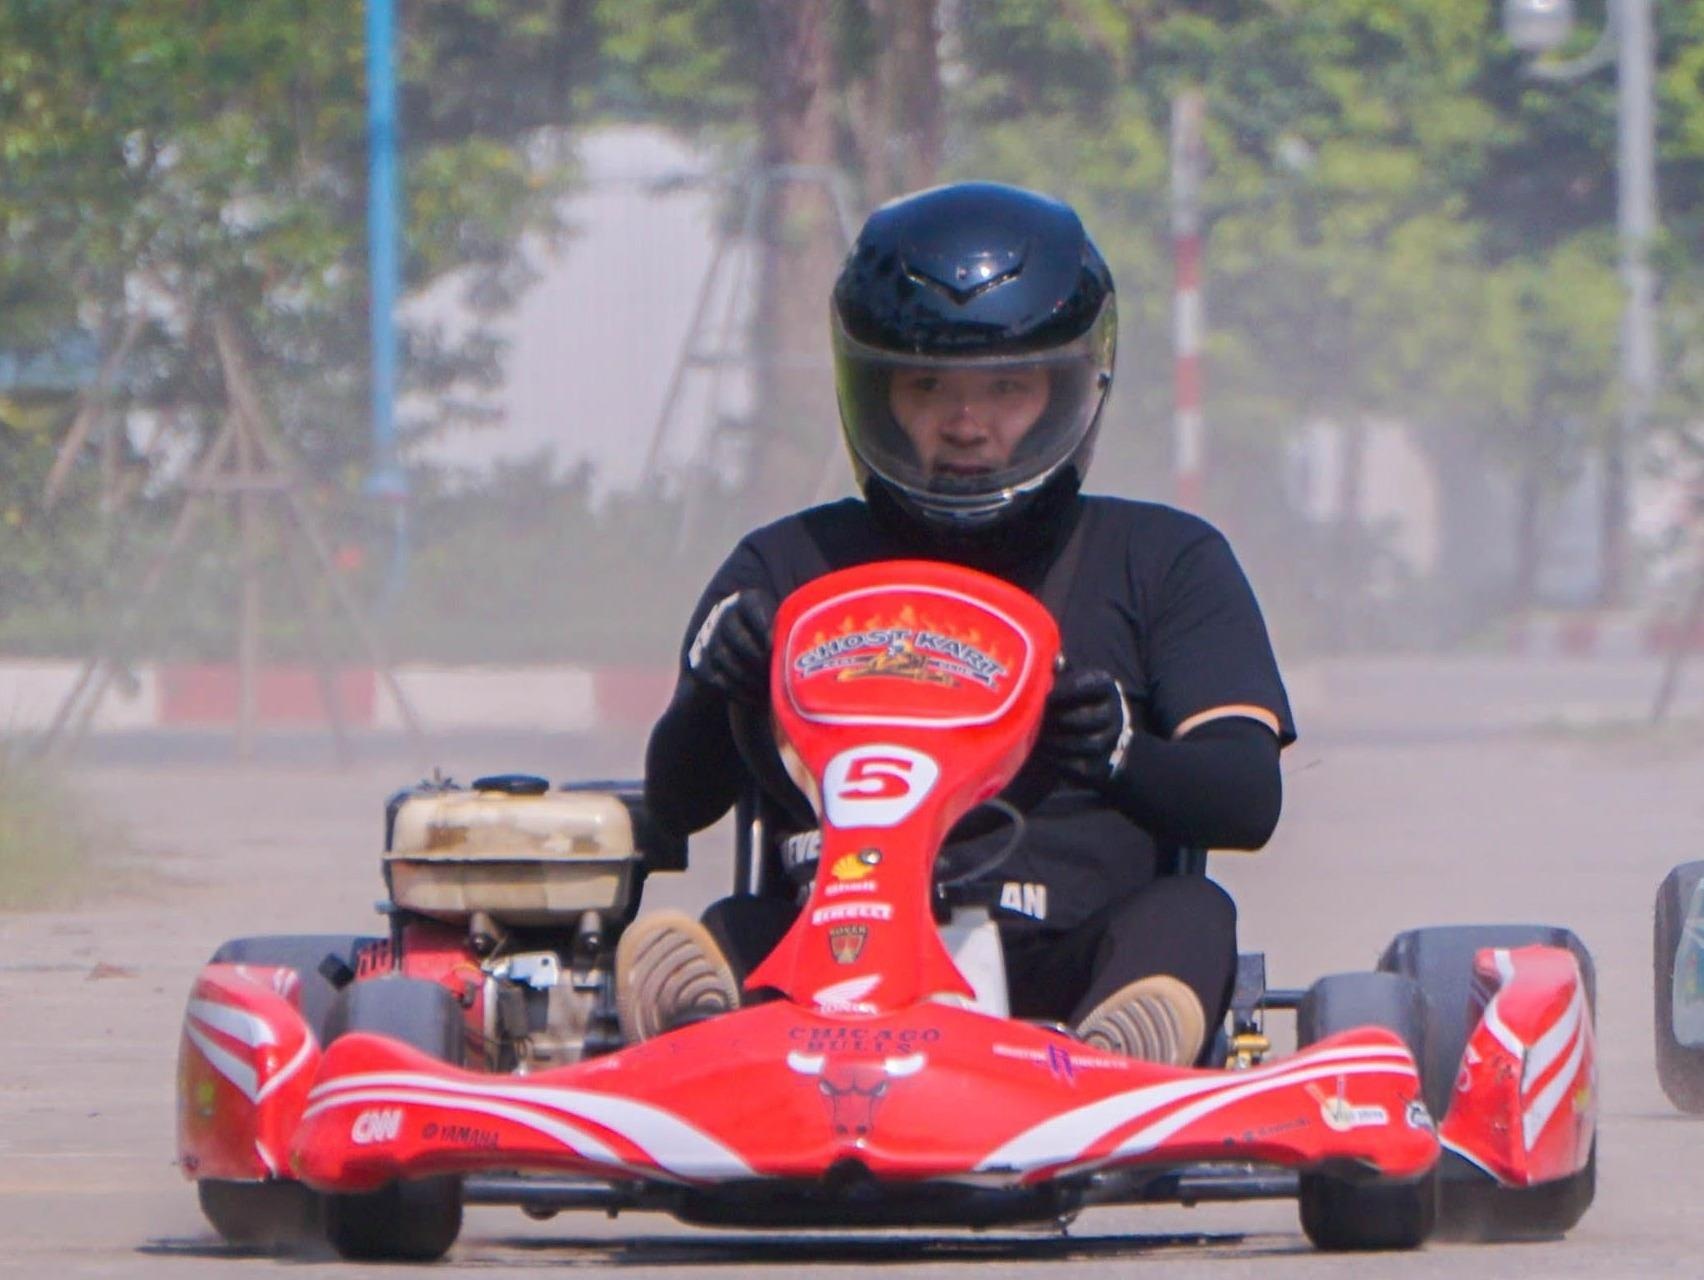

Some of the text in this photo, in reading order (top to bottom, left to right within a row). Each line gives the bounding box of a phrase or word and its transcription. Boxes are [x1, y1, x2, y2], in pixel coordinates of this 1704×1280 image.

[796, 629, 1009, 677] GHOST KART
[838, 757, 912, 801] 5
[351, 1107, 403, 1145] CNN
